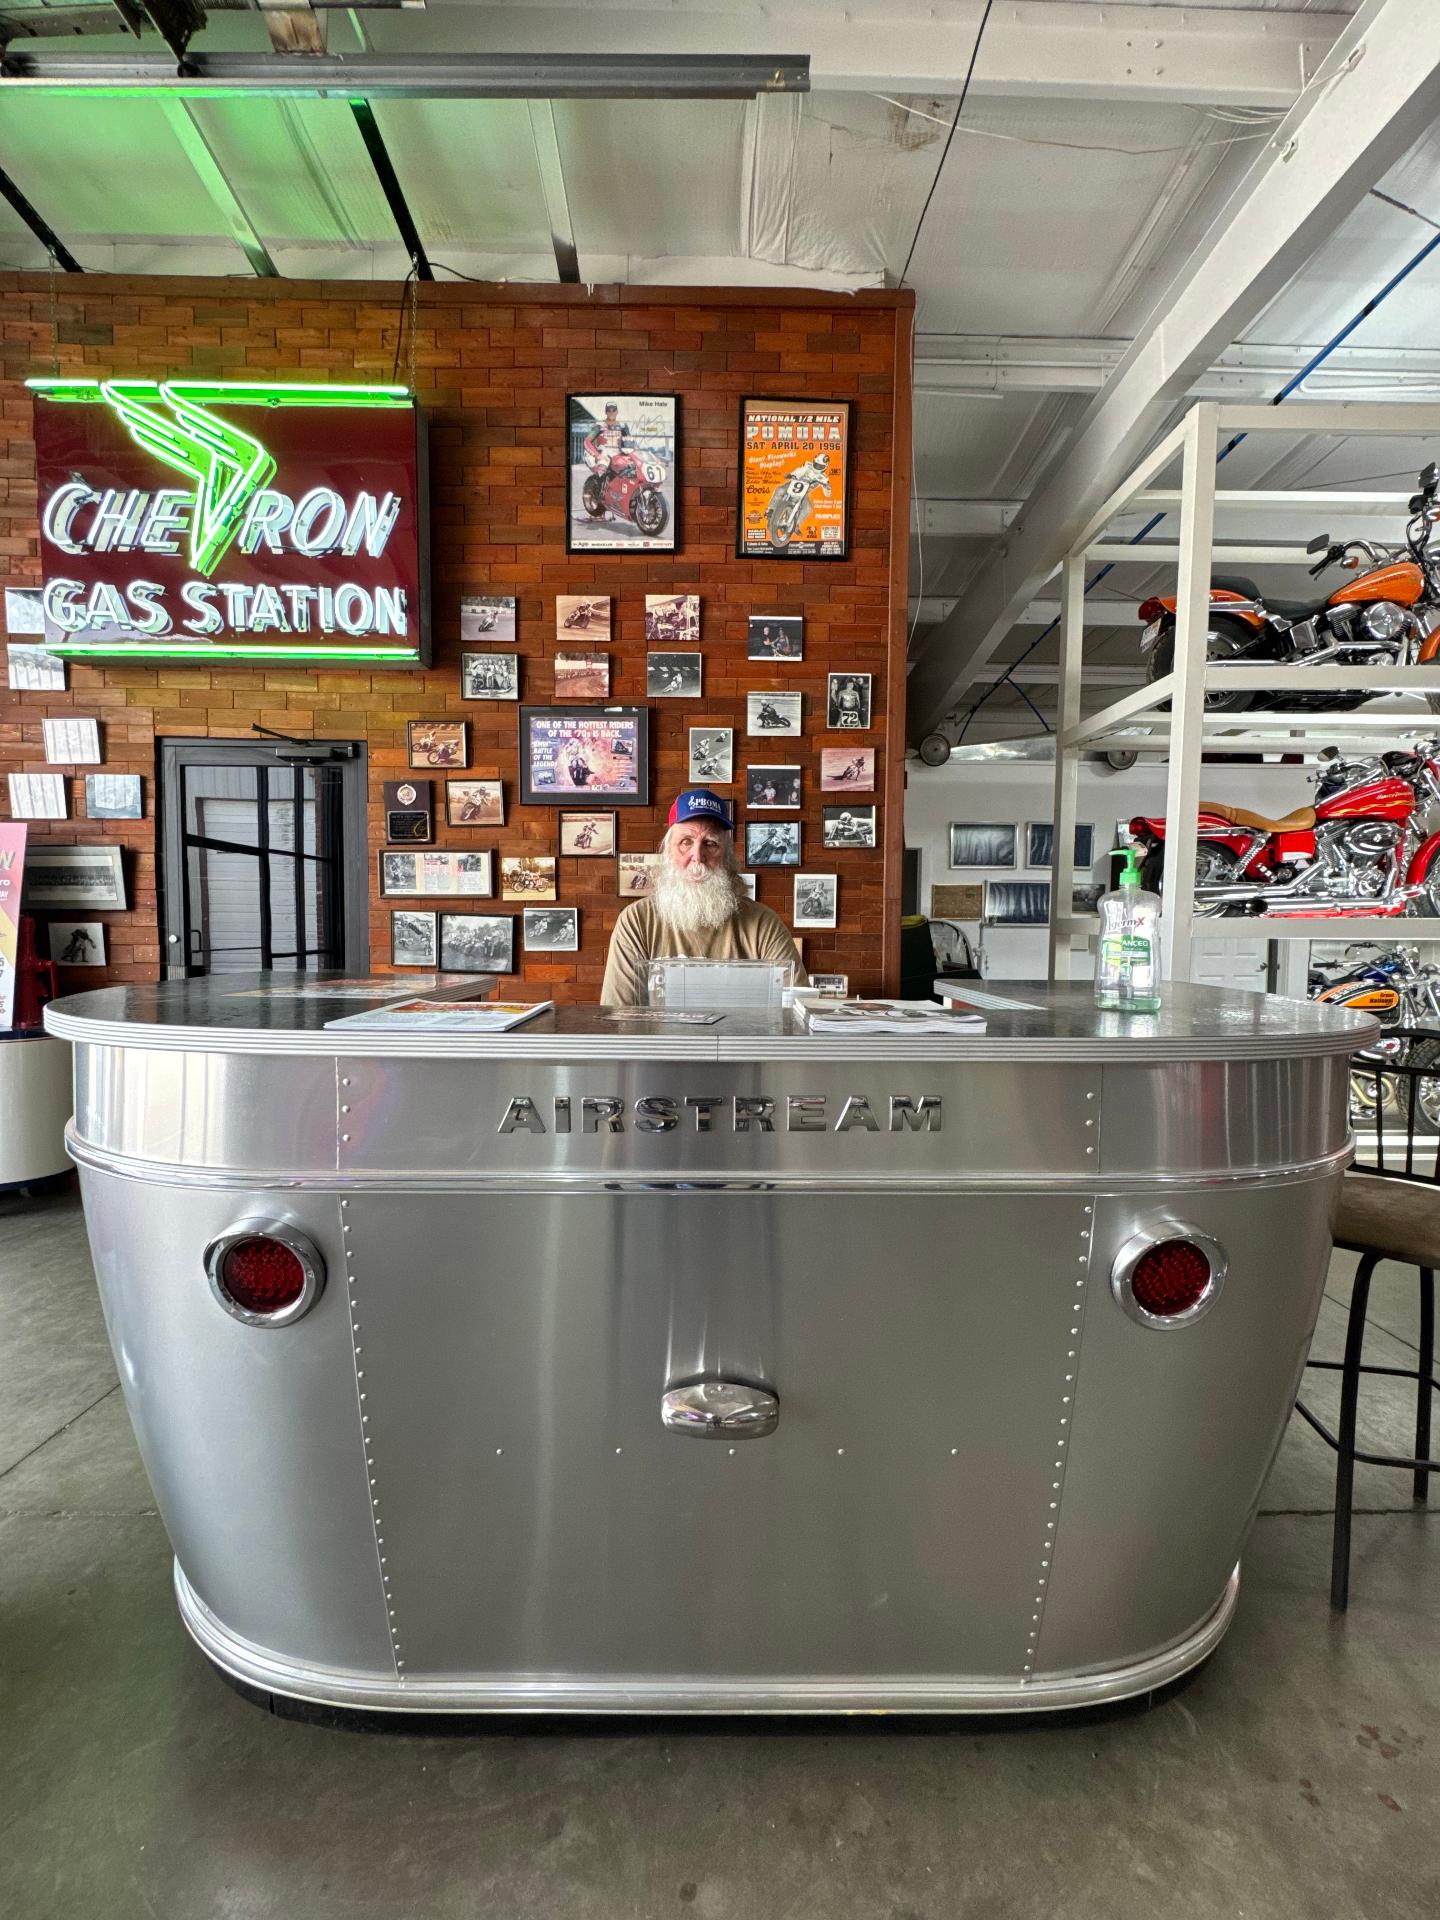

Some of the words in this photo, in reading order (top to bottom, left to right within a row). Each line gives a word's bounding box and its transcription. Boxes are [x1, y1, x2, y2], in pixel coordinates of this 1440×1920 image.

[815, 415, 840, 423] MILE
[746, 424, 841, 441] POMONA
[747, 441, 766, 450] SAT
[771, 442, 800, 450] APRIL
[802, 442, 815, 450] 20
[819, 442, 841, 451] 1996
[792, 481, 805, 494] 9
[43, 480, 402, 577] CHEVRON
[43, 577, 173, 637] GAS
[181, 579, 409, 638] STATION
[536, 720, 551, 729] ONE
[552, 720, 562, 729] OF
[564, 720, 577, 729] THE
[578, 720, 607, 729] HOTTEST
[609, 720, 634, 729] RIDERS
[842, 712, 859, 725] 72
[547, 729, 557, 738] OF
[559, 729, 572, 738] THE
[592, 729, 599, 737] IS
[497, 1095, 943, 1133] AIRSTREAM
